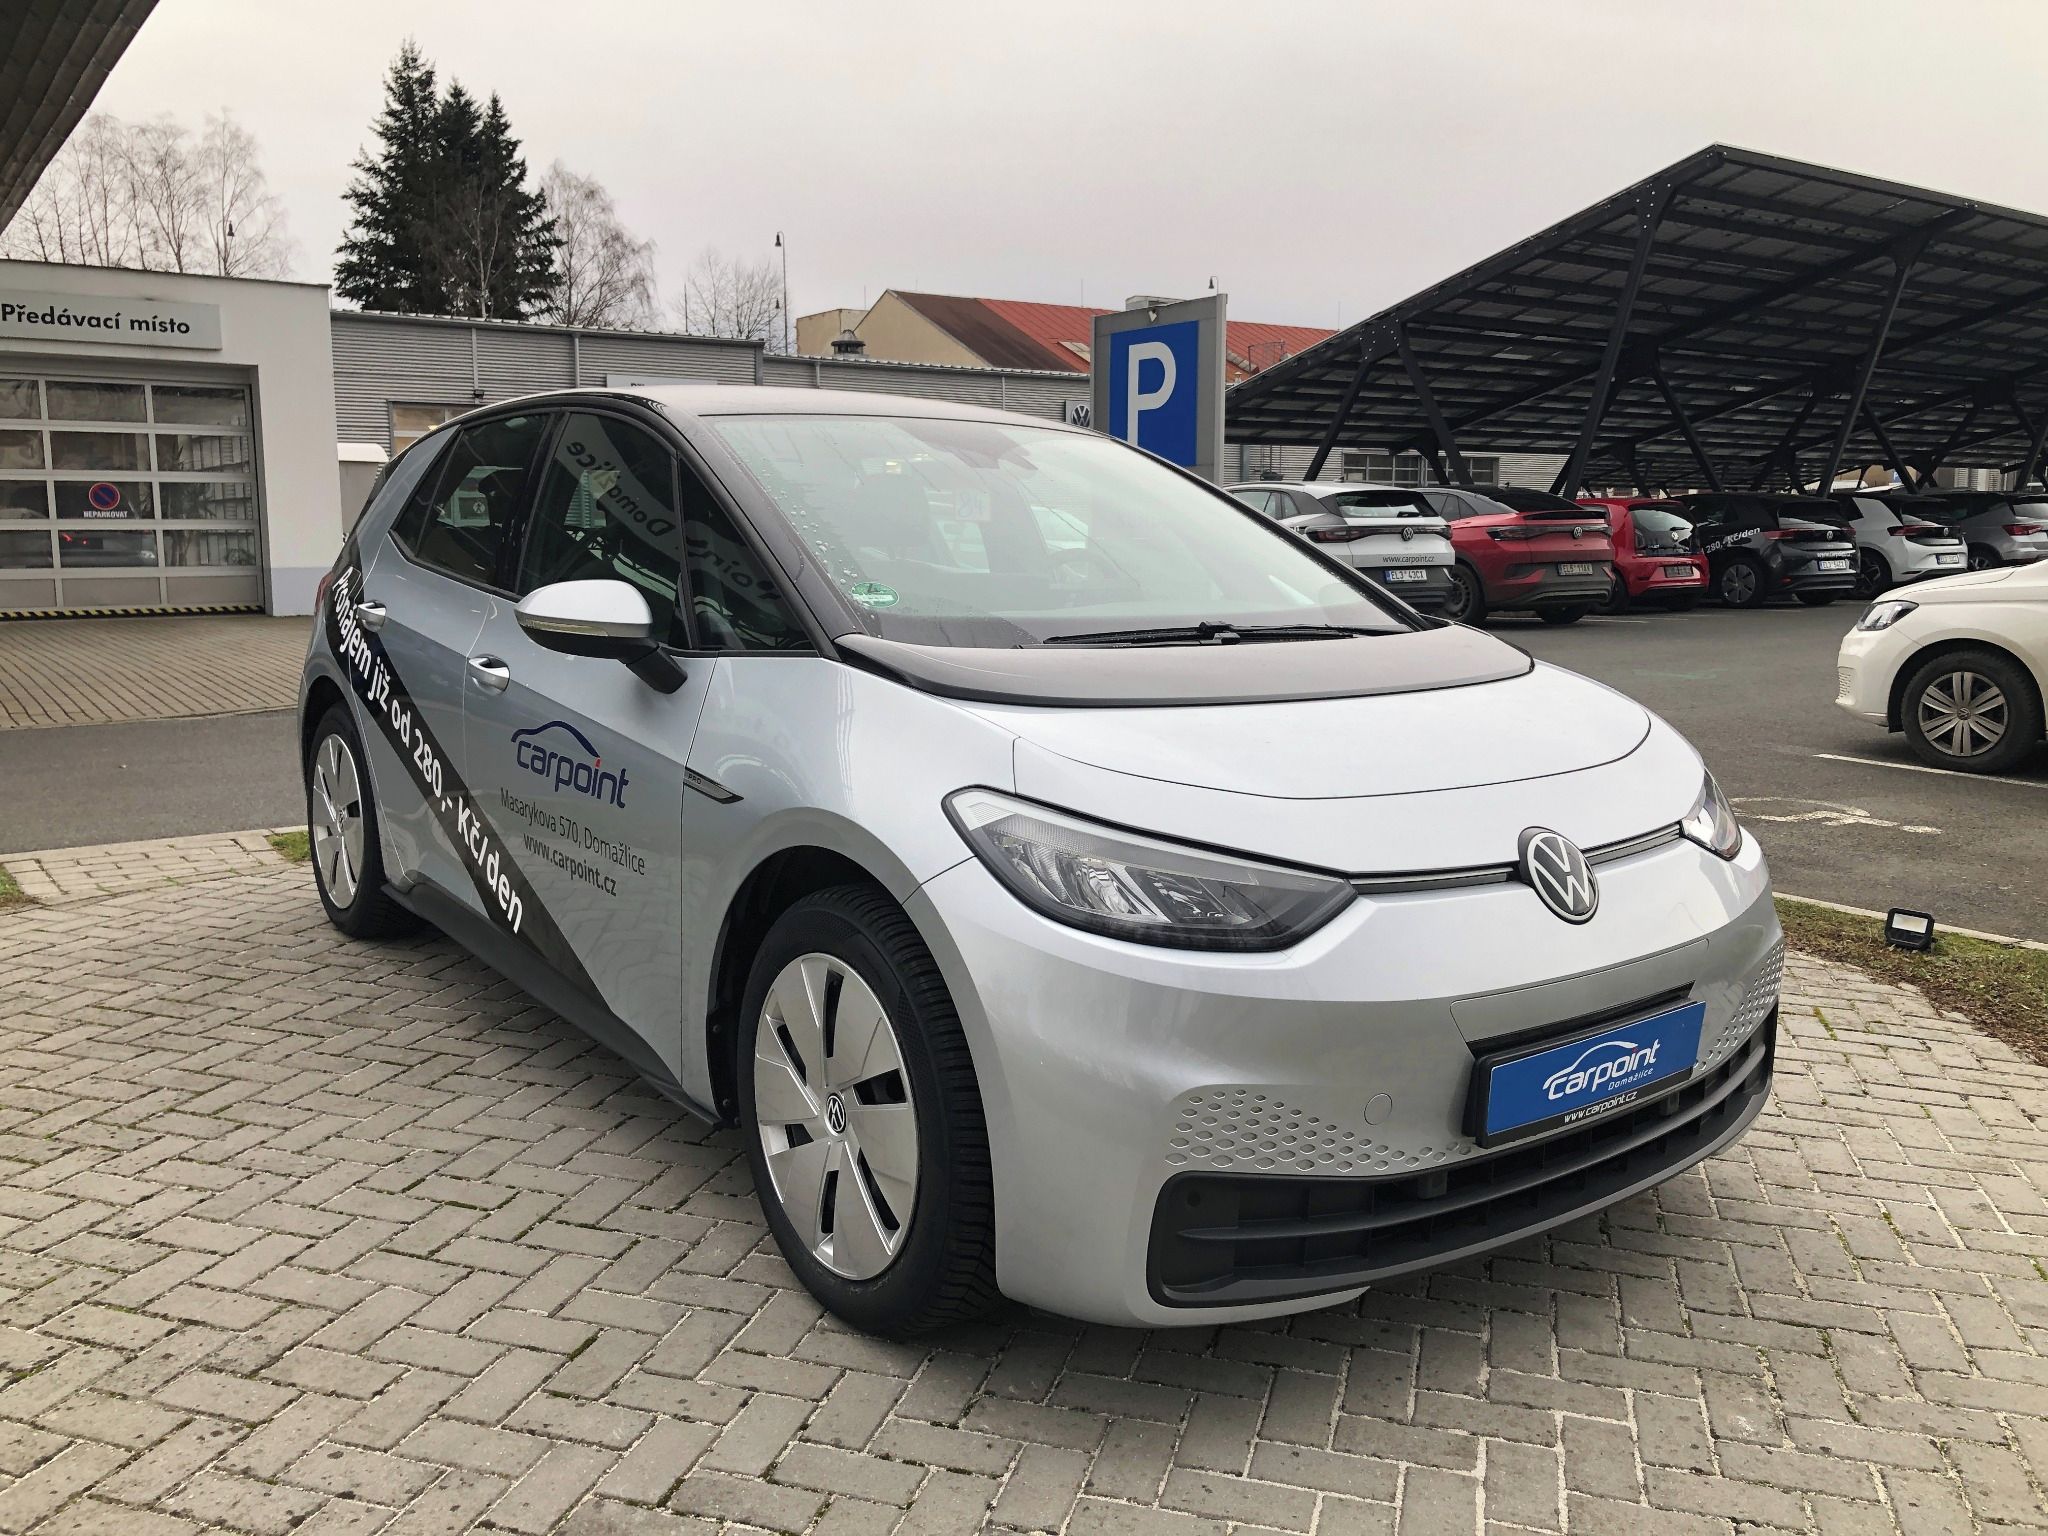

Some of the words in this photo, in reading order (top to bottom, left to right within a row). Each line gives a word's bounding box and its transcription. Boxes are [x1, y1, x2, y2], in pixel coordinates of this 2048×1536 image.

[1, 303, 121, 330] Předávací
[130, 315, 191, 335] místo
[1128, 341, 1177, 447] P
[83, 510, 128, 519] NEPARKOVAT
[1382, 554, 1435, 564] www.carpoint.cz
[332, 566, 372, 680] Pronájem
[368, 656, 391, 713] již
[391, 699, 412, 748] od
[413, 728, 453, 813] 280,-
[457, 795, 524, 934] Kč/den
[516, 740, 630, 809] carpoint
[687, 773, 702, 785] PRO
[500, 787, 557, 833] Masarykova
[559, 815, 582, 849] 570,
[584, 826, 646, 876] Domažlice
[523, 832, 617, 897] www.carpoint.cz
[1547, 1038, 1661, 1101] carpoint
[1607, 1066, 1654, 1091] Domažlice
[1564, 1090, 1638, 1124] www.carpoint.cz
